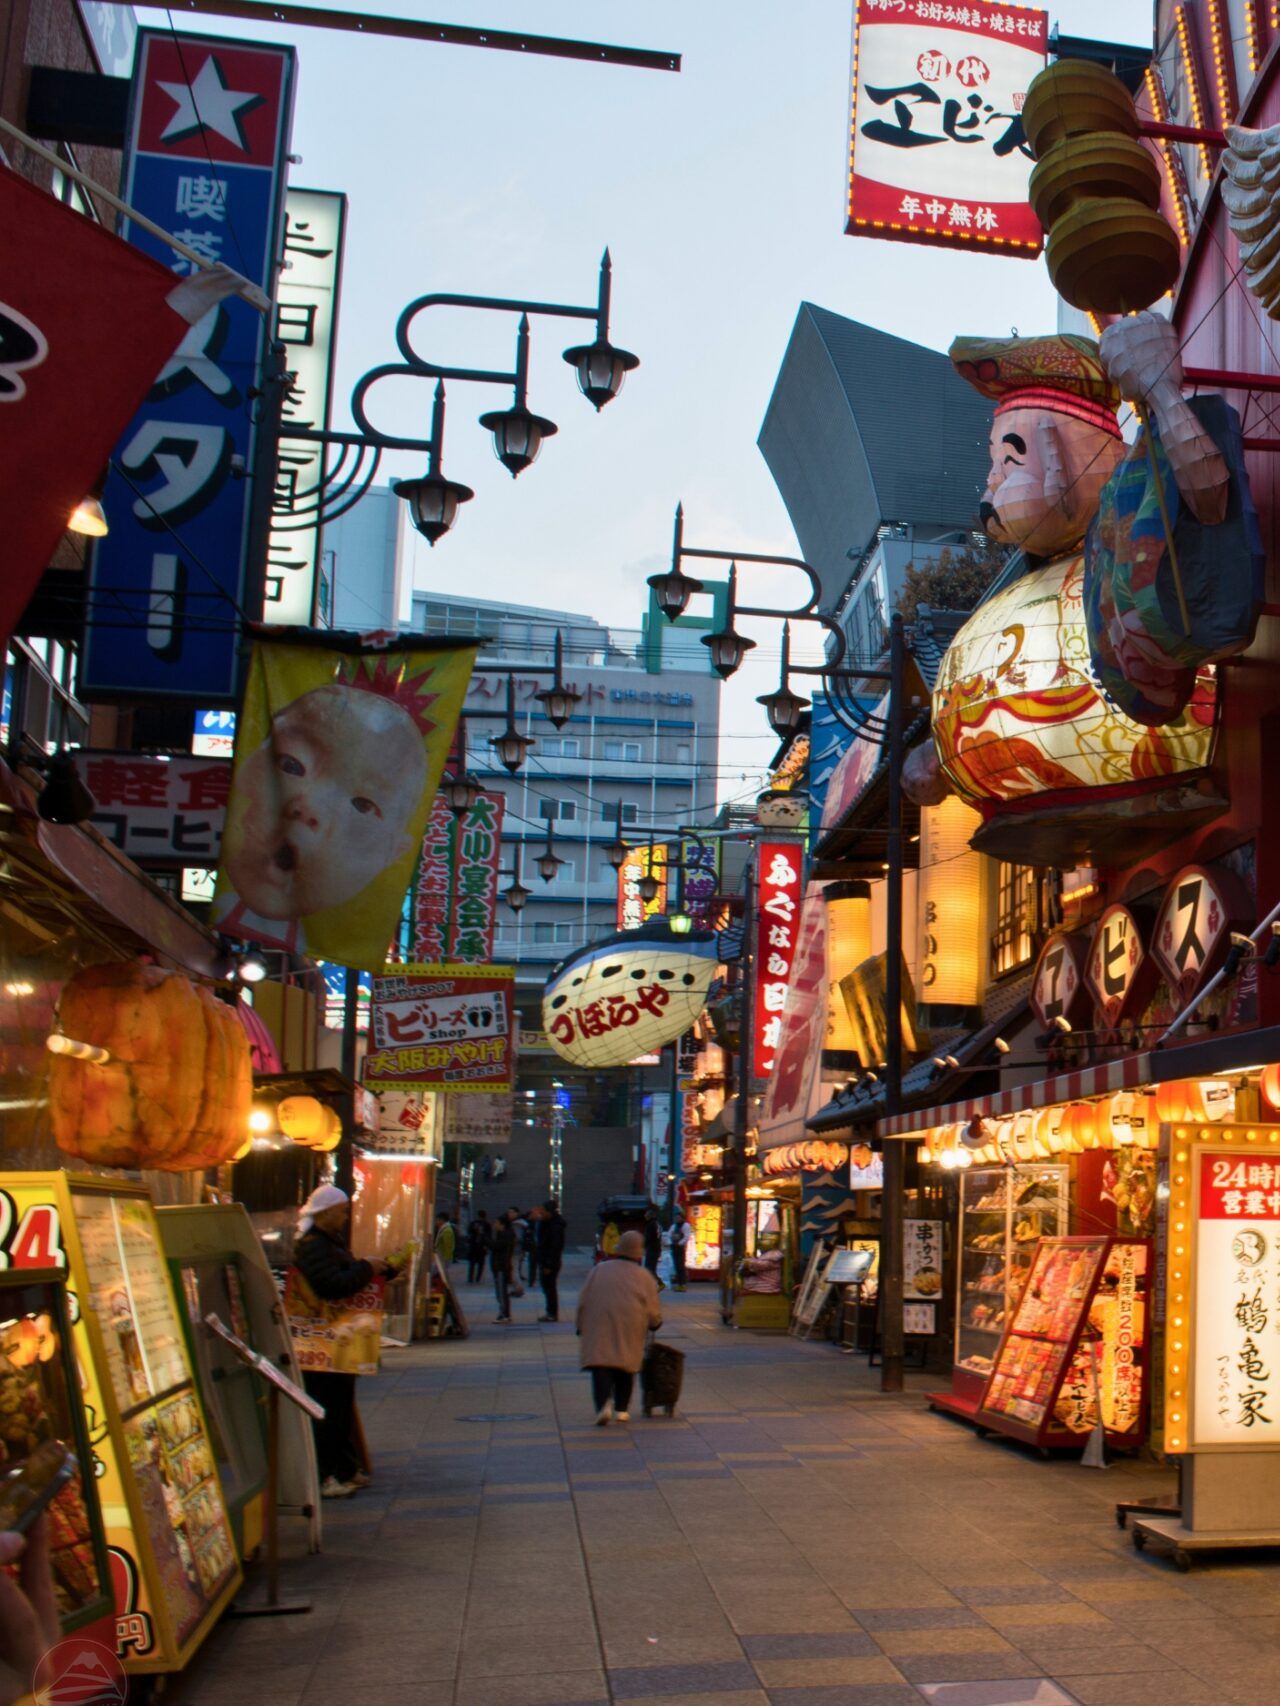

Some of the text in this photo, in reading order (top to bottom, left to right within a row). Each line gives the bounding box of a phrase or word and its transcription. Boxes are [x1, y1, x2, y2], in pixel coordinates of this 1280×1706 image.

[918, 51, 990, 86] 初代
[171, 175, 228, 276] 喫茶
[898, 195, 999, 231] 年中無休
[121, 302, 233, 650] スター
[86, 760, 231, 811] 軽食
[95, 813, 223, 852] コーヒ
[762, 854, 798, 1070] ふぐなら四
[385, 1002, 467, 1042] ビリーズ
[550, 982, 671, 1045] づぼらや
[369, 1037, 506, 1074] 大阪みやげ
[1234, 1286, 1273, 1428] 鶴亀家
